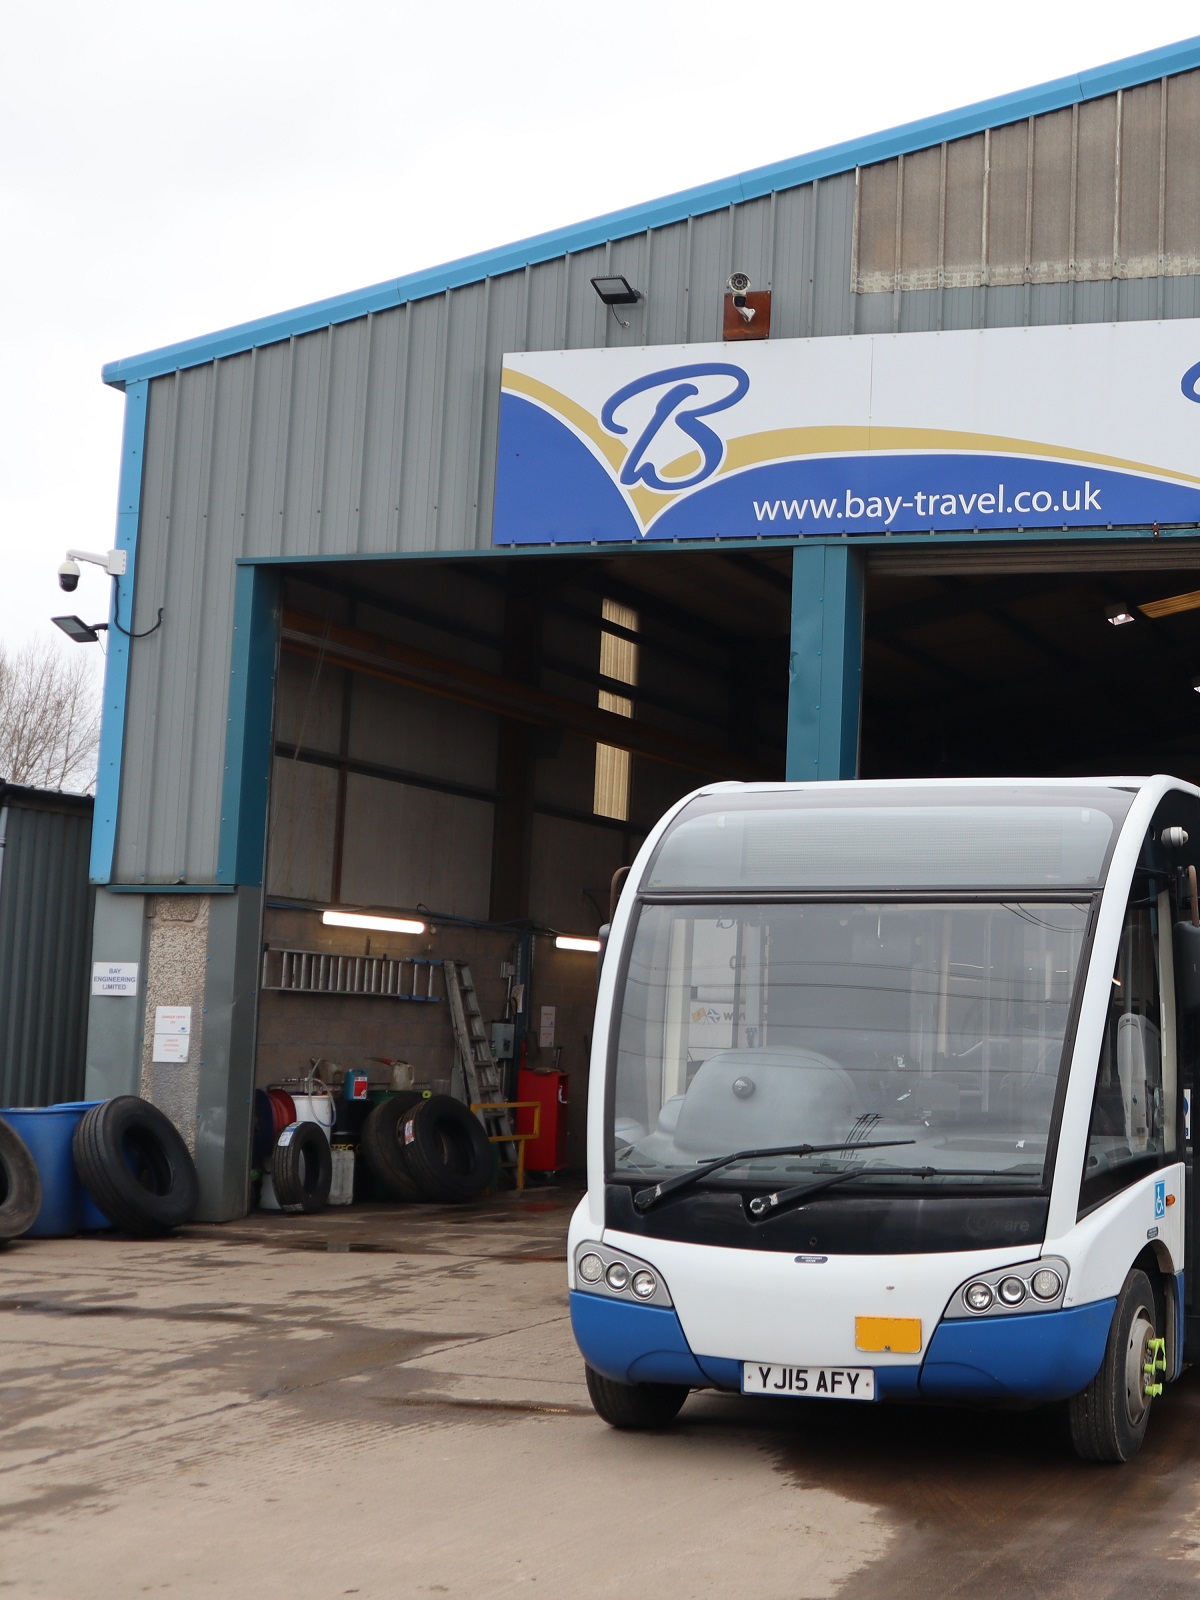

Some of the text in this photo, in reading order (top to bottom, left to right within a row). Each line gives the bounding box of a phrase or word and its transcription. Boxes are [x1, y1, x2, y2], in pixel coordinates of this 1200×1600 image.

[752, 482, 1102, 525] www.bay-travel.co.uk
[758, 1366, 860, 1394] YJ15 AFY
